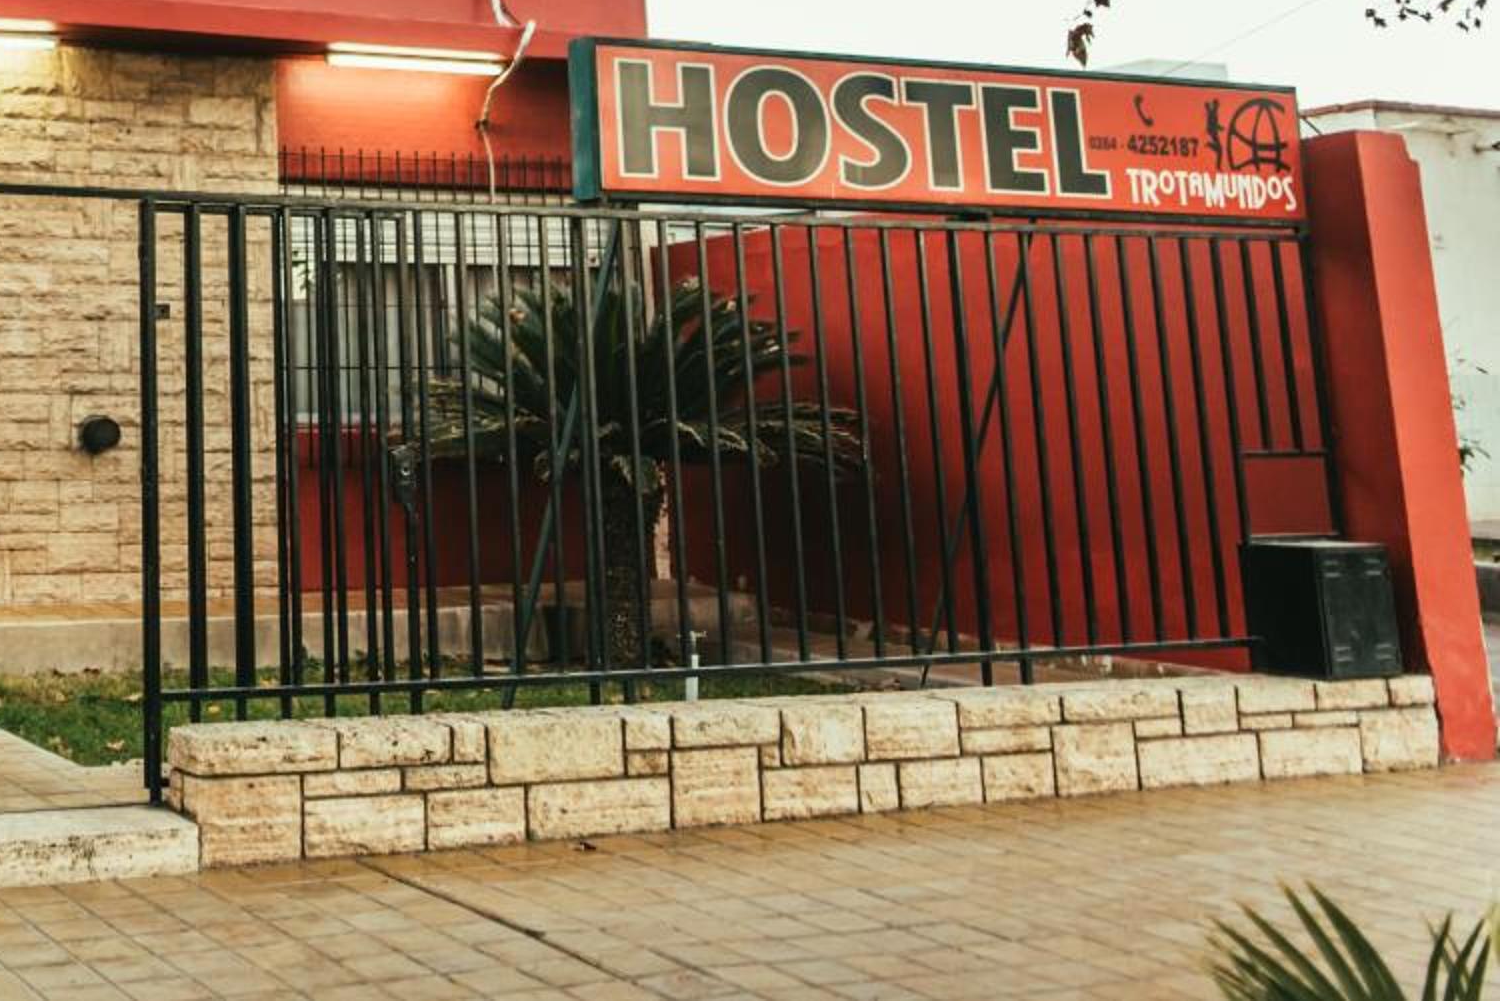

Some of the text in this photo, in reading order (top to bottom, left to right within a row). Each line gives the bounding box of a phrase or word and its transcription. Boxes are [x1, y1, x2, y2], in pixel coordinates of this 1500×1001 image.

[613, 58, 1112, 199] HOSTEL
[1127, 134, 1199, 157] 4252187
[1125, 168, 1297, 211] TROTAMUNDOS
